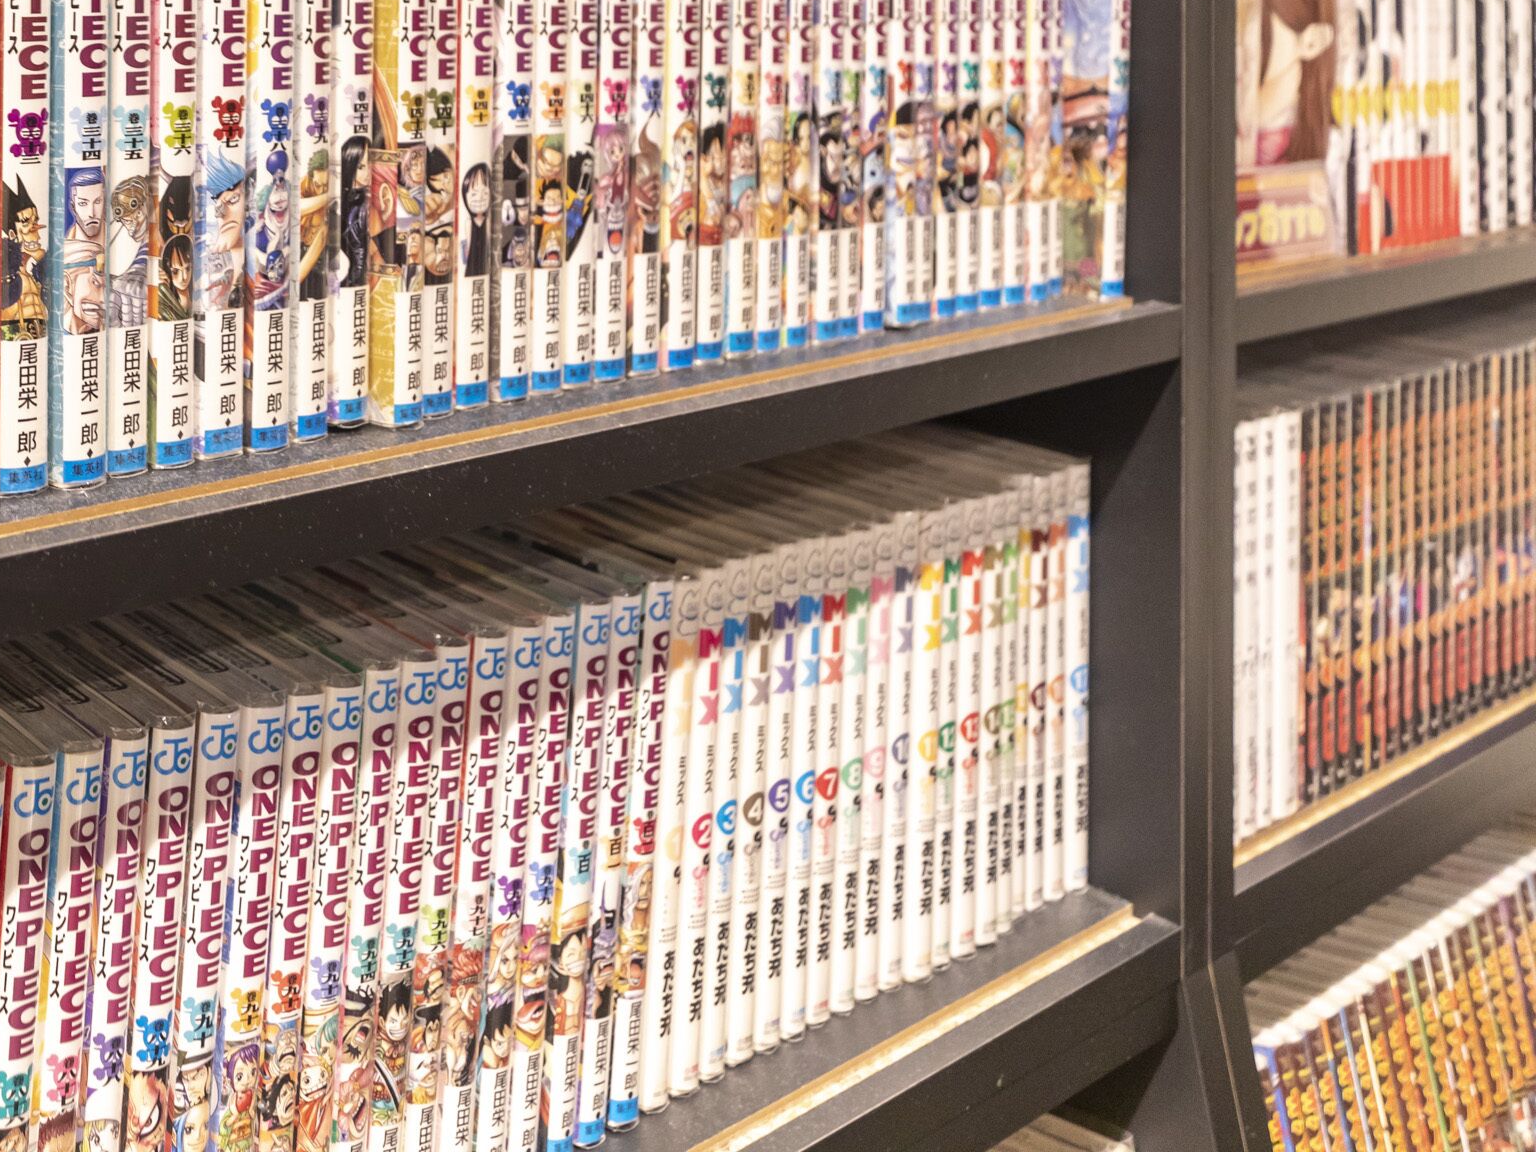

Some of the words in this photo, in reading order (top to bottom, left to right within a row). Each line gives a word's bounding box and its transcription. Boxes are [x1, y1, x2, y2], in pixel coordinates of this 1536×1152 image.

[408, 293, 422, 390] 尾田栄一郎
[470, 278, 485, 371] 尾田栄一郎
[545, 270, 559, 359] 尾田栄一郎
[81, 336, 99, 445] 尾田栄一郎
[123, 329, 141, 435] 尾田栄一郎
[220, 312, 237, 415] 尾田栄一郎
[586, 656, 607, 721] ONE
[408, 717, 433, 789] ONE
[579, 726, 602, 839] PIECE
[69, 815, 97, 897] ONE
[158, 786, 188, 866] ONE
[204, 772, 234, 848] ONE
[399, 794, 427, 914] PIECE
[149, 871, 181, 1007] PIECE
[197, 854, 228, 988] PIECE
[59, 903, 91, 1042] PIECE
[592, 1020, 609, 1112] 尾田栄一郎
